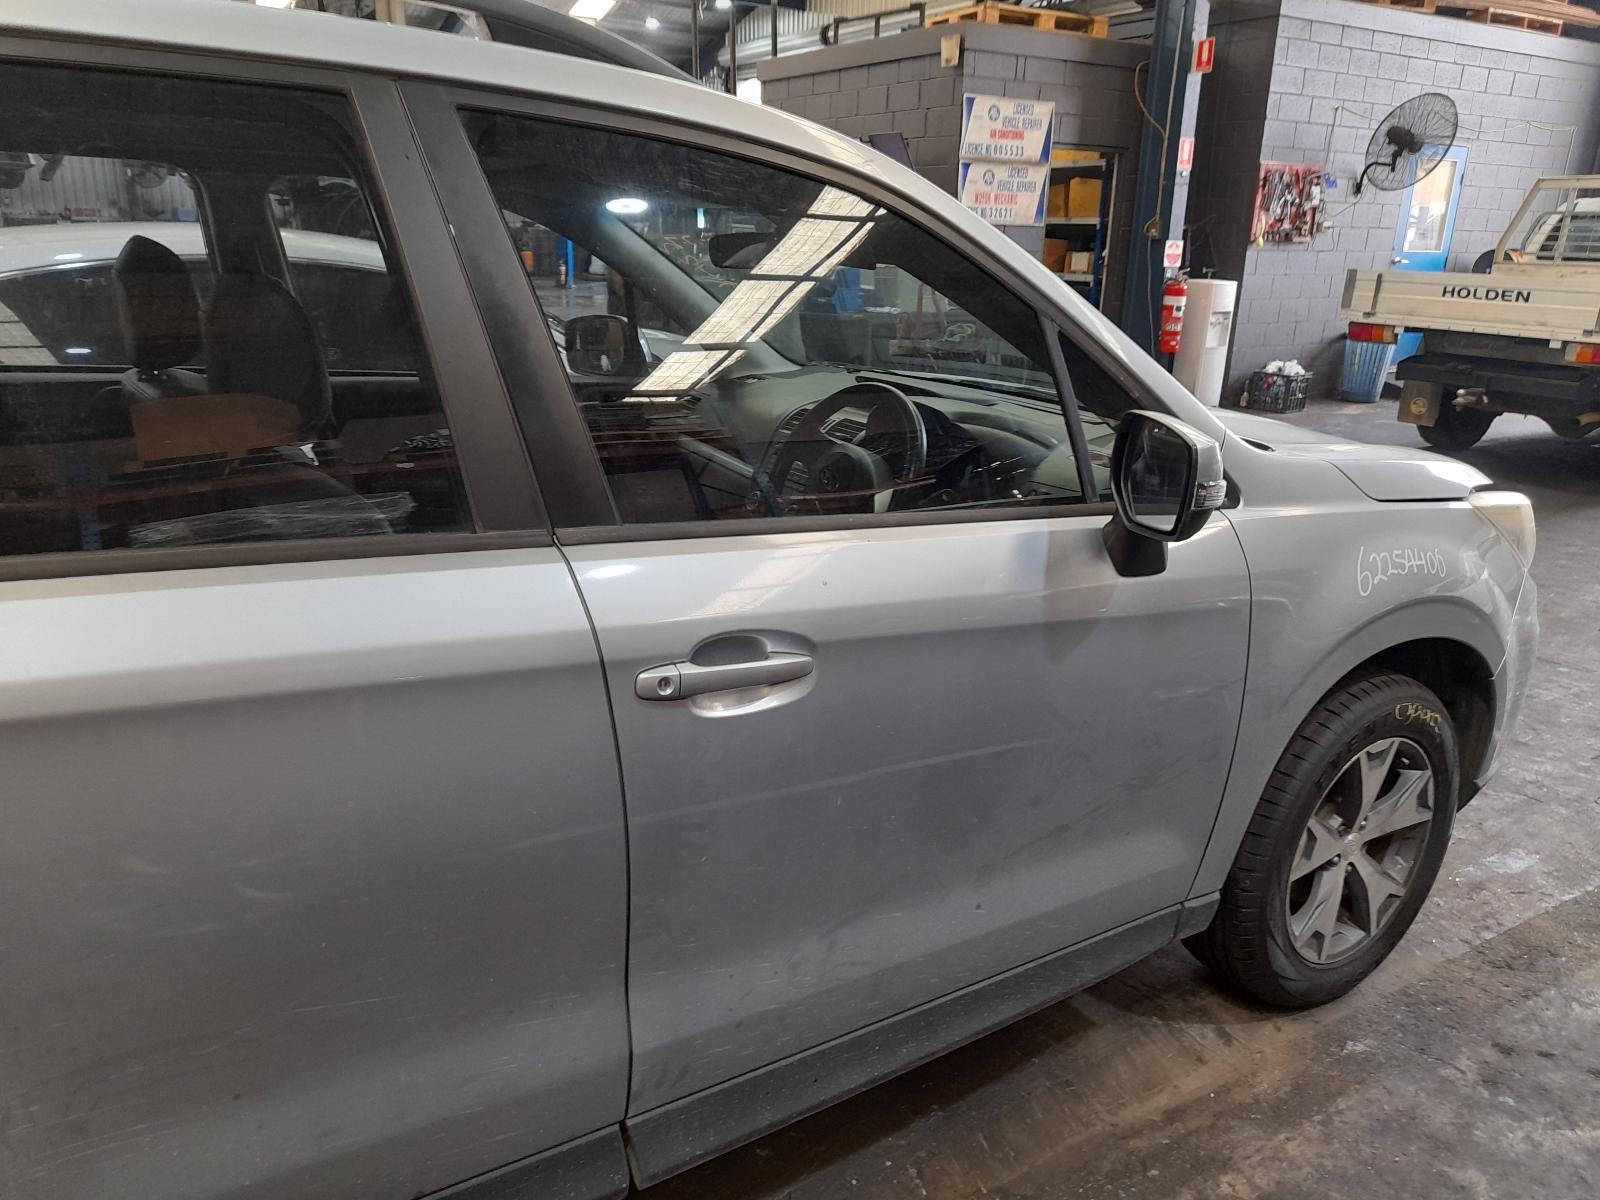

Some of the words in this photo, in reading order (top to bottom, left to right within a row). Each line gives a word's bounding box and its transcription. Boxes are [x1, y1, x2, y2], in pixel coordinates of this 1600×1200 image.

[1013, 102, 1035, 116] LICENSED
[1002, 116, 1019, 129] VEHICLE
[994, 144, 1024, 157] 005533
[1008, 166, 1029, 179] LICENSED
[997, 179, 1014, 192] VEHICLE
[975, 192, 991, 205] MOTOR
[994, 193, 1018, 206] MECHANIC
[989, 207, 1013, 219] 32621
[1441, 285, 1532, 303] HOLDEN
